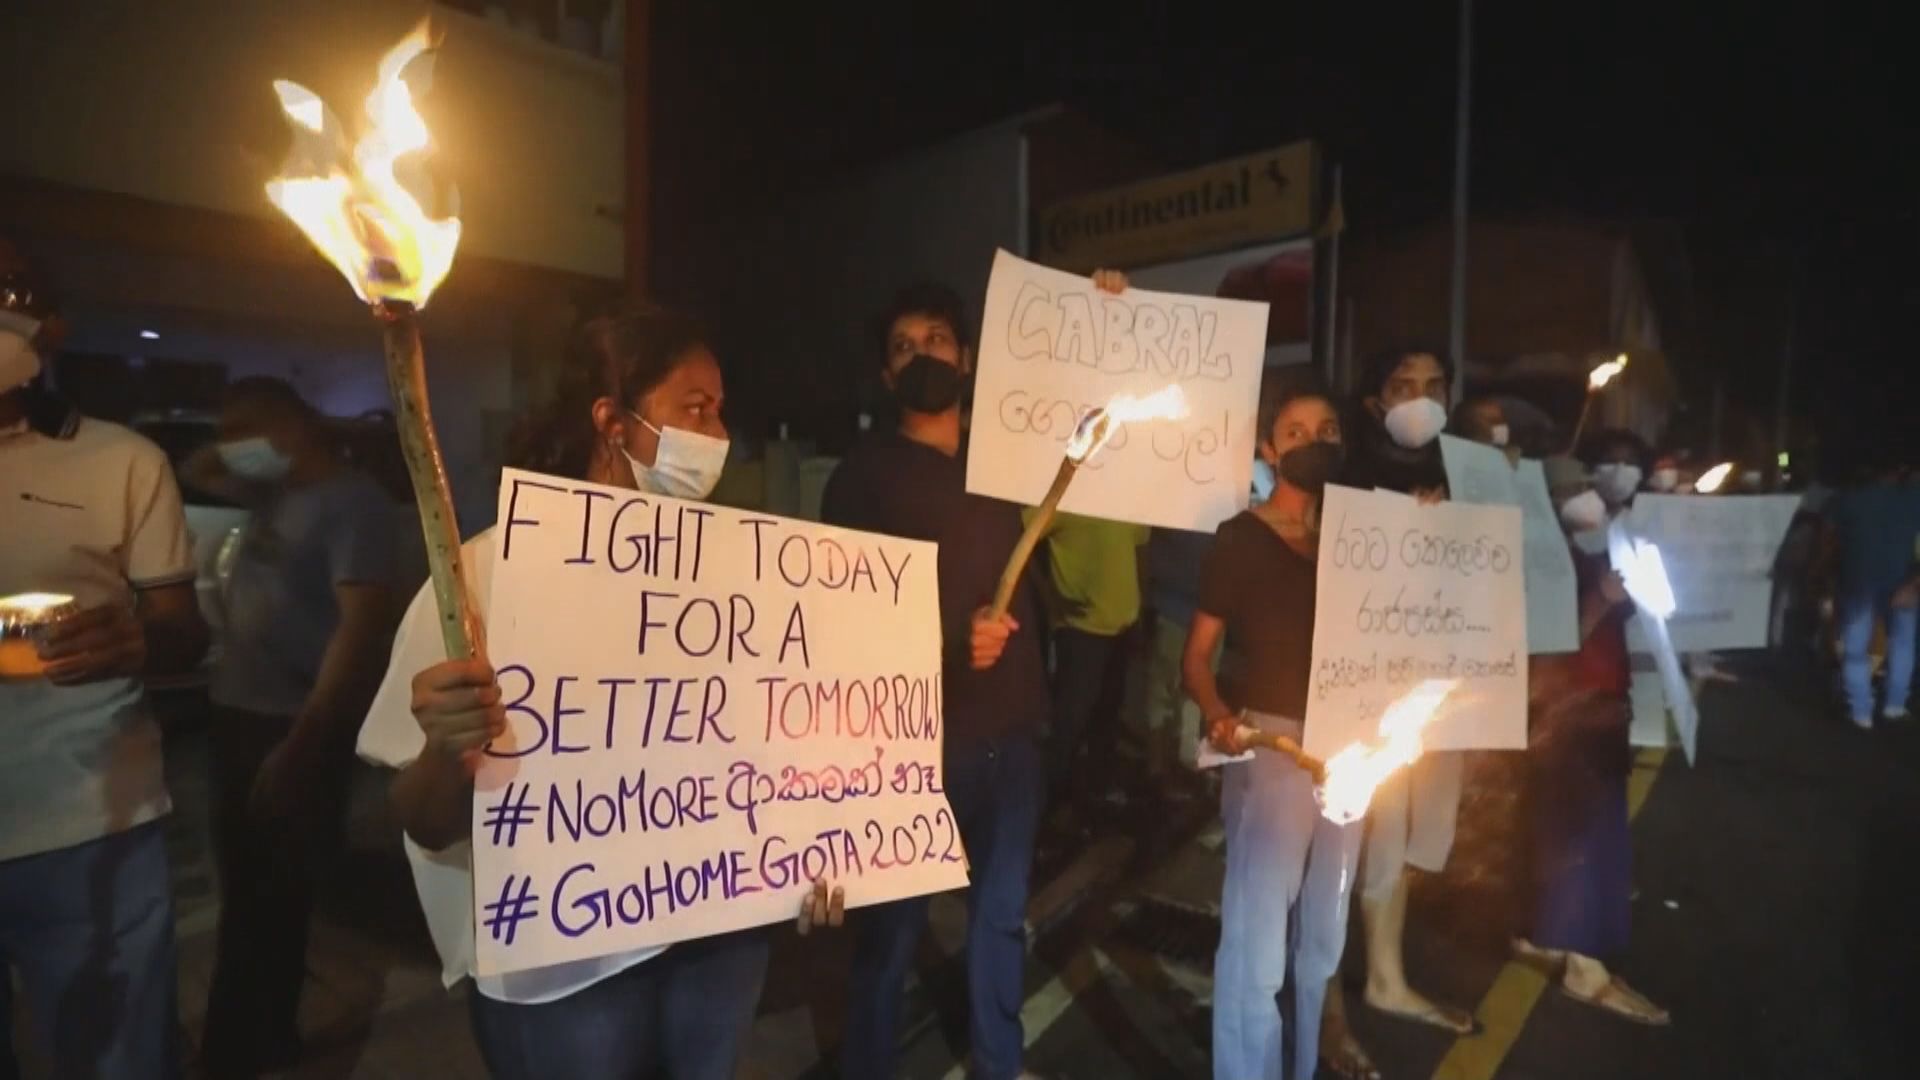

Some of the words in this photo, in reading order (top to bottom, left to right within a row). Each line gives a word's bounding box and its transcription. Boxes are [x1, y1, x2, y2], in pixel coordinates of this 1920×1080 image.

[1008, 281, 1232, 382] CABRAL
[503, 479, 714, 583] FIGHT
[739, 519, 912, 606] TODAY
[638, 590, 761, 664] FOR
[778, 601, 810, 668] A
[482, 664, 736, 758] BETTER
[756, 671, 942, 743] TOMORROW
